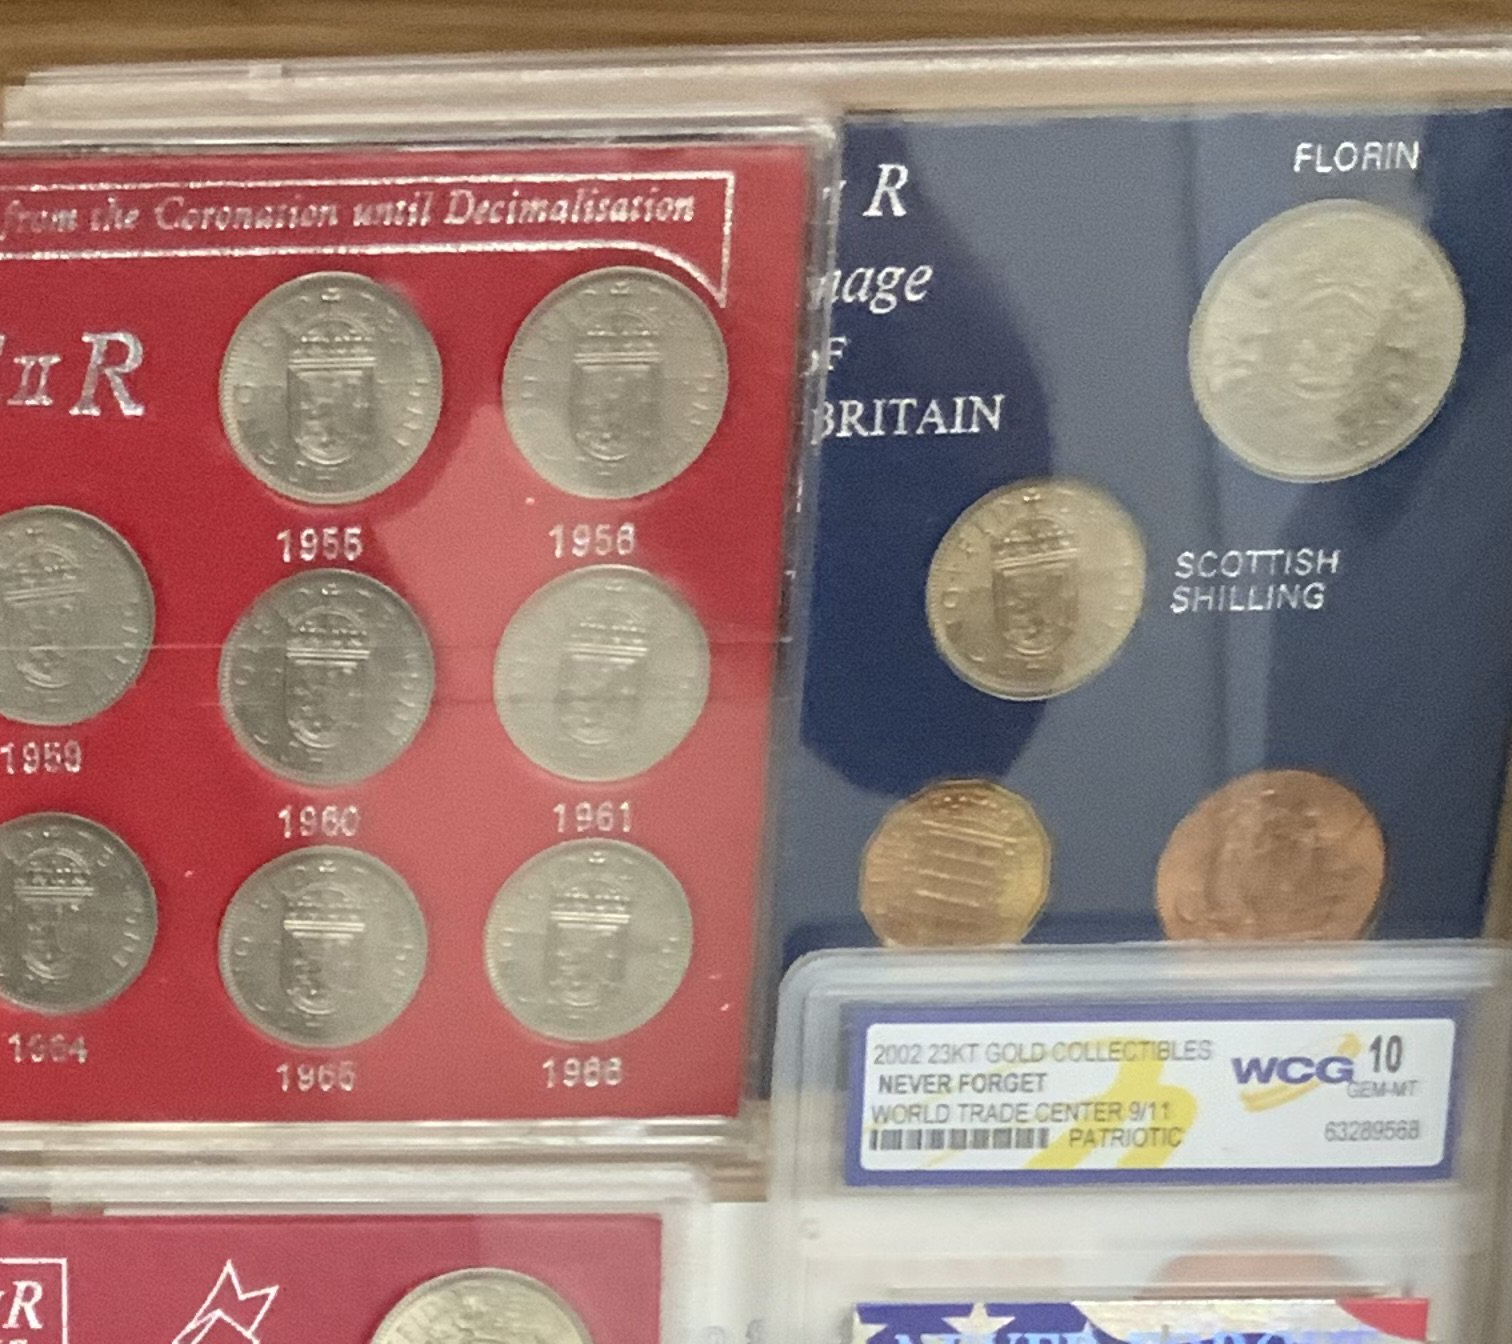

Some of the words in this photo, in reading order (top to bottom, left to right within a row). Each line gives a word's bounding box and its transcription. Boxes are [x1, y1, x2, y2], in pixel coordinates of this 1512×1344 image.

[1293, 140, 1420, 173] FLORIN
[90, 197, 140, 232] the
[154, 195, 338, 231] Coronation
[352, 191, 431, 229] until
[443, 187, 696, 227] Decimalisation
[1175, 549, 1341, 579] SCOTTISH
[1170, 584, 1326, 615] SHILLING
[873, 1043, 921, 1065] 2002
[927, 1042, 980, 1064] 23KT
[986, 1042, 1047, 1064] GOLD
[1053, 1039, 1214, 1063] COLLECTIBLES
[1369, 1034, 1403, 1073] 10
[878, 1073, 951, 1094] NEVER
[958, 1072, 1049, 1094] FORGET
[1231, 1056, 1355, 1084] WCG
[871, 1103, 950, 1125] WORLD
[956, 1102, 1030, 1124] TRADE
[1034, 1101, 1123, 1123] CENTER
[1129, 1100, 1174, 1122] 9/11
[1069, 1126, 1185, 1148] PATRIOTIC
